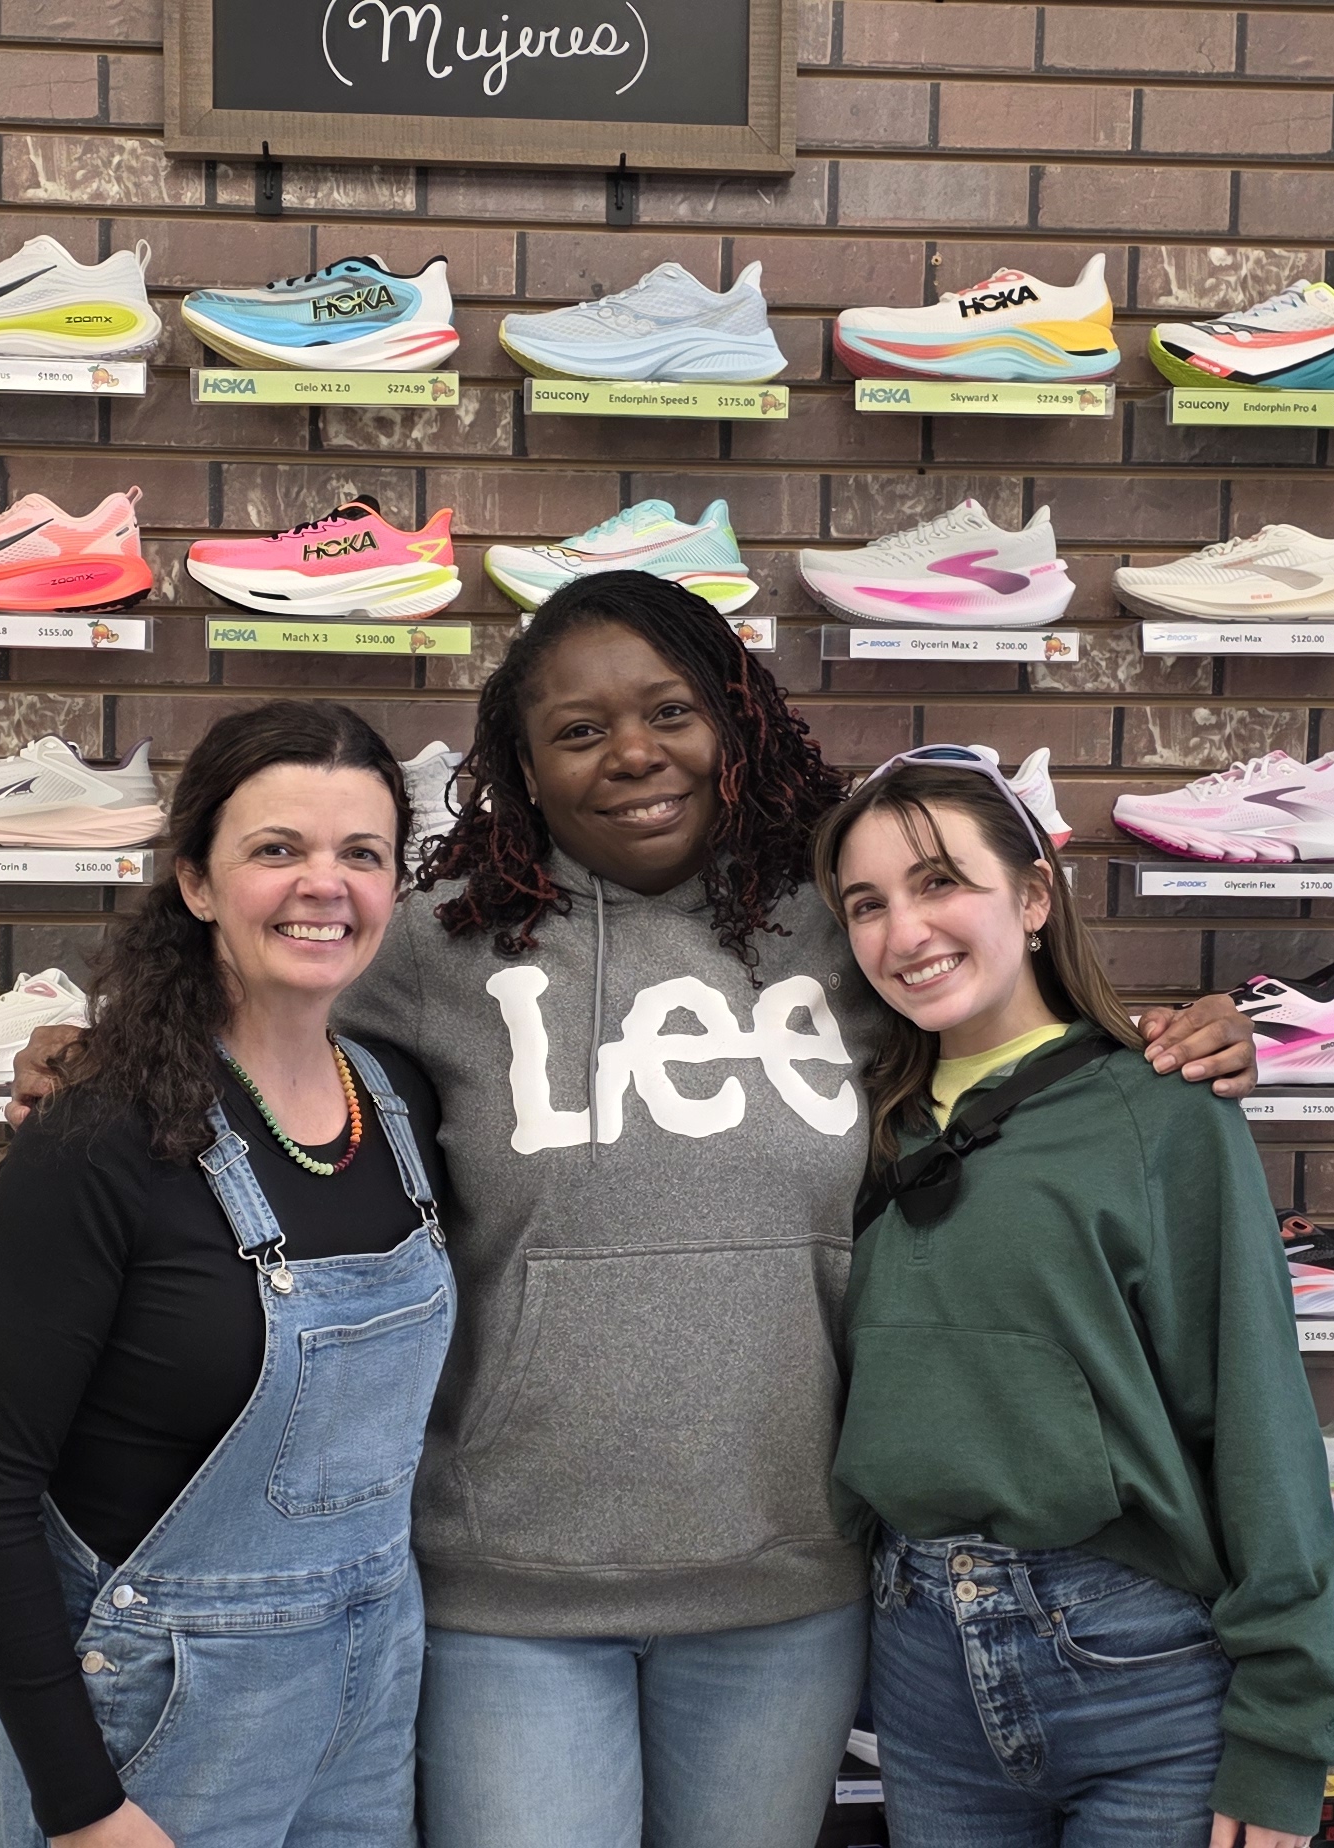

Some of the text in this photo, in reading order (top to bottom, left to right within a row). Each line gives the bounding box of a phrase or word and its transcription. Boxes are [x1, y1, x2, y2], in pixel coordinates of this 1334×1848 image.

[310, 285, 396, 322] HOKA
[958, 285, 1041, 319] HOKA
[37, 372, 73, 382] $180.00
[202, 378, 425, 394] HOKA Cielo X1 2.0 $274.99
[535, 390, 755, 407] saucony Endorphin Speed 5 $175.00
[859, 387, 1074, 404] HOKA Skyward X $224.99
[1177, 399, 1229, 412] saucony
[1244, 403, 1291, 414] Endorphin
[1293, 404, 1309, 413] Pro
[1311, 404, 1317, 412] 4
[302, 530, 379, 562] HOKA
[38, 627, 73, 637] $155.00
[214, 628, 395, 645] HOKA Mach X 3 $190.00
[1220, 634, 1324, 644] Revel Max $120.00
[869, 640, 1028, 651] BROOKS Glycerin Max 2 $200.00
[22, 863, 28, 871] 8
[75, 863, 111, 873] $160.00
[1176, 880, 1332, 891] BROOKS Glycerin Flex $170.00
[485, 965, 858, 1155] Lee
[1264, 1105, 1334, 1114] 23 $175.00
